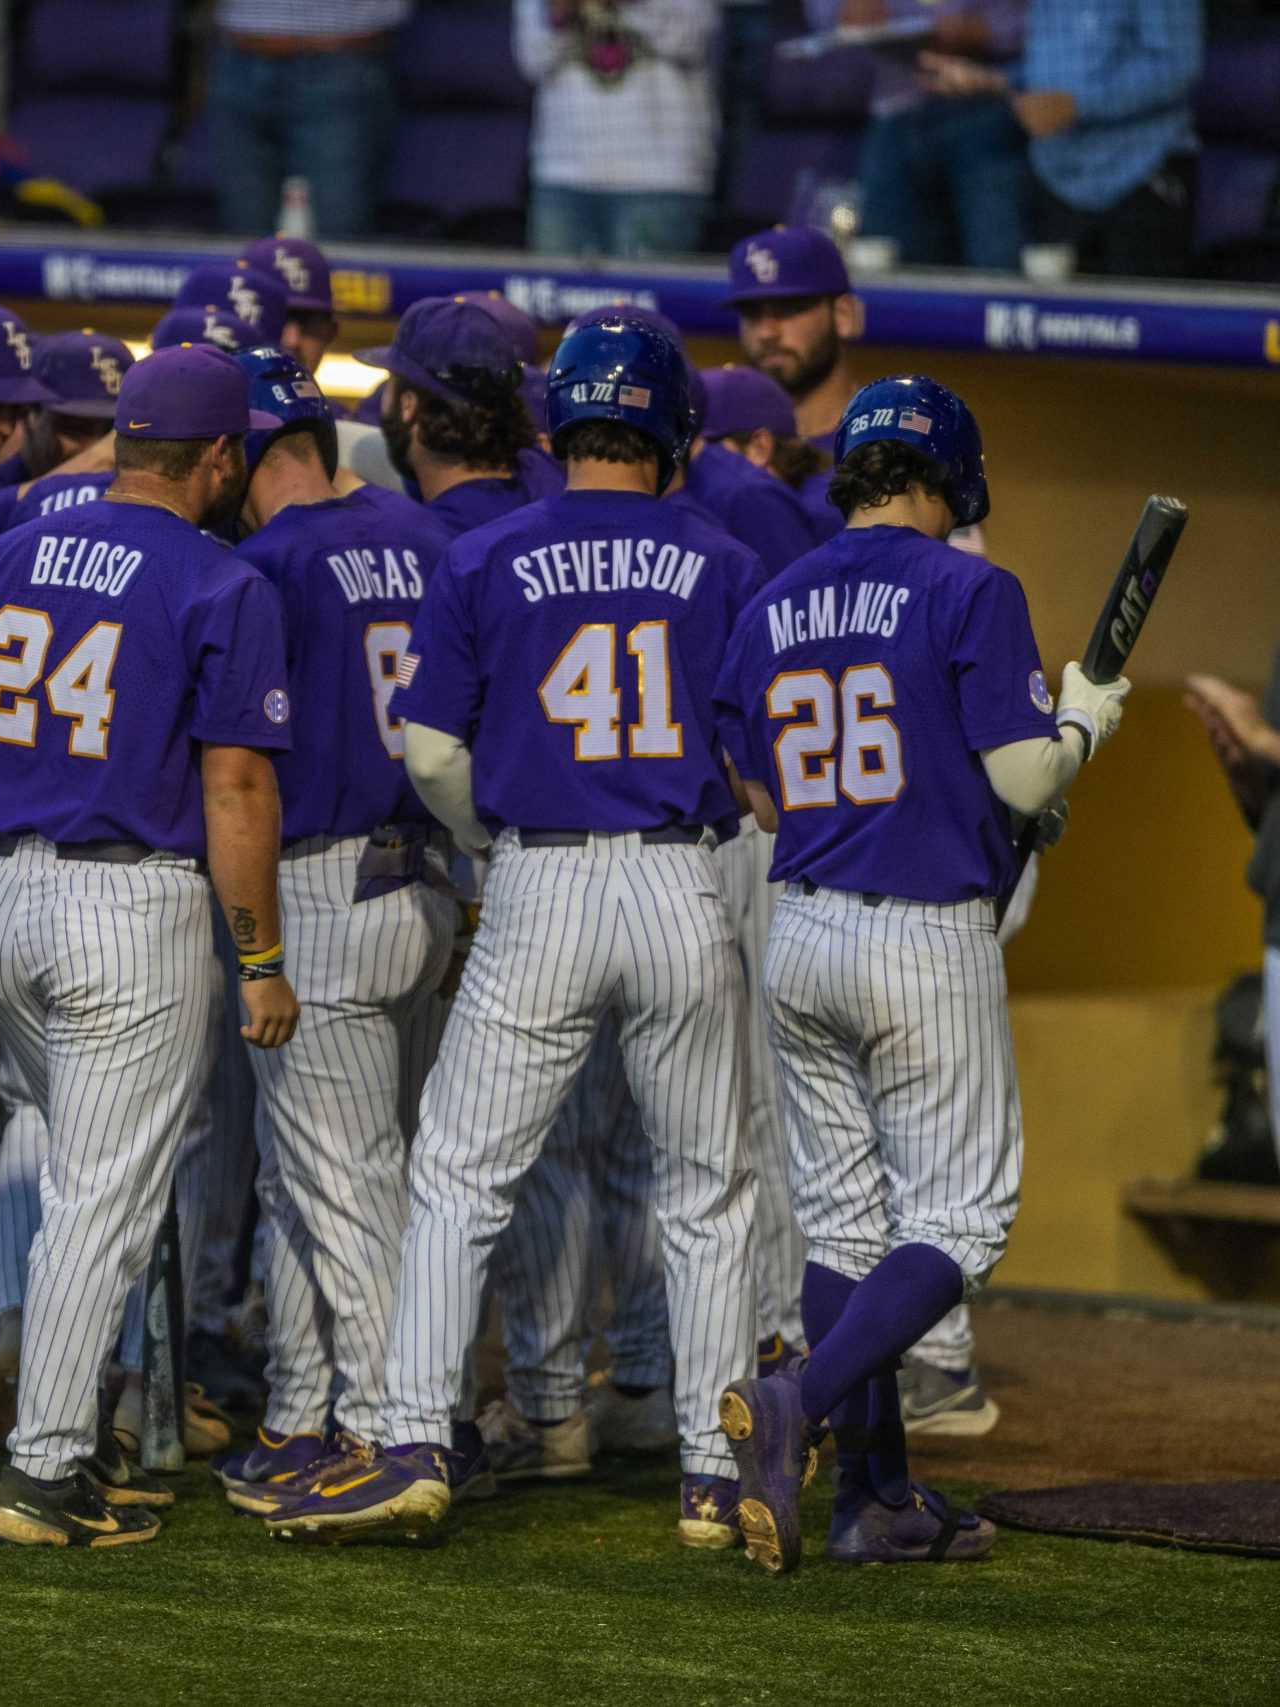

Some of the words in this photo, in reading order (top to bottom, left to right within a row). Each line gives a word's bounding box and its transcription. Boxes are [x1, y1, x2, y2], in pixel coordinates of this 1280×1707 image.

[570, 383, 588, 403] 41
[850, 414, 870, 436] 26
[30, 535, 143, 597] BELOSO
[327, 548, 424, 604] DUGAS
[512, 538, 706, 603] STEVENSON
[536, 618, 684, 761] 41
[765, 661, 906, 812] 26
